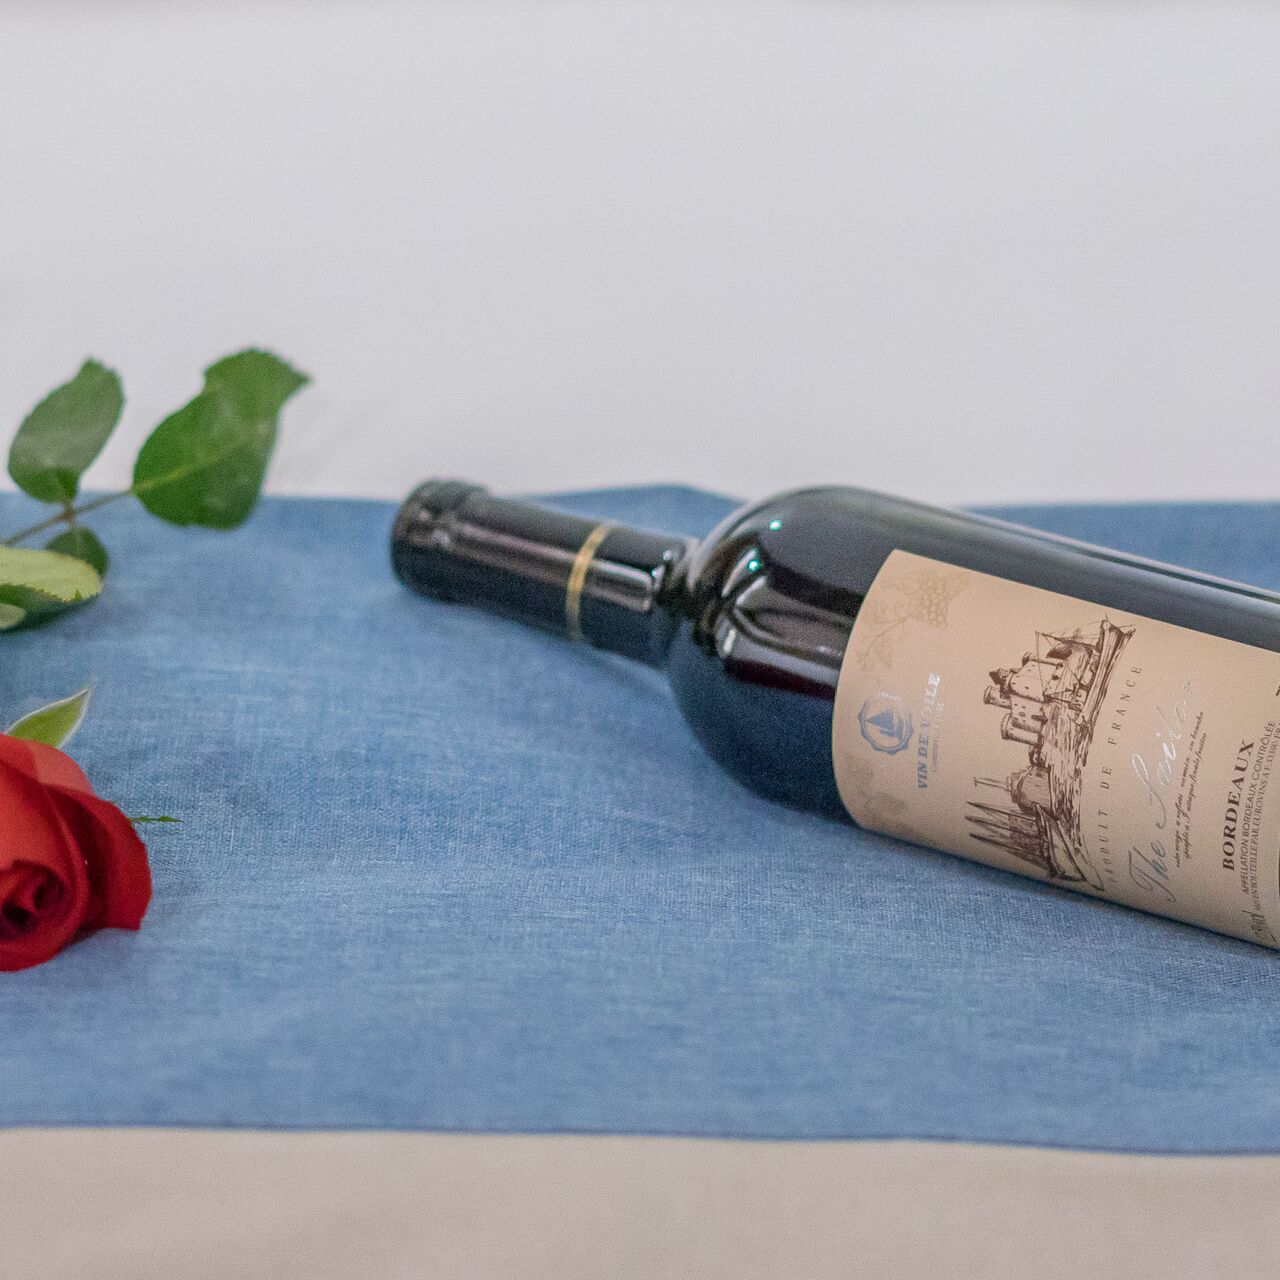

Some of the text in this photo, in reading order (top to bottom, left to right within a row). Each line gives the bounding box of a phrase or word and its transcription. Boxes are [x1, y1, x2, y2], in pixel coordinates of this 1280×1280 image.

[918, 734, 928, 758] DE
[1100, 767, 1112, 790] DE
[1107, 666, 1142, 745] FRANCE
[917, 763, 928, 789] VIN
[1222, 740, 1254, 872] BORDEAUX
[1240, 719, 1275, 894] APPELLATION BORDEAUX CONTRÔLÉE
[1127, 841, 1176, 903] The
